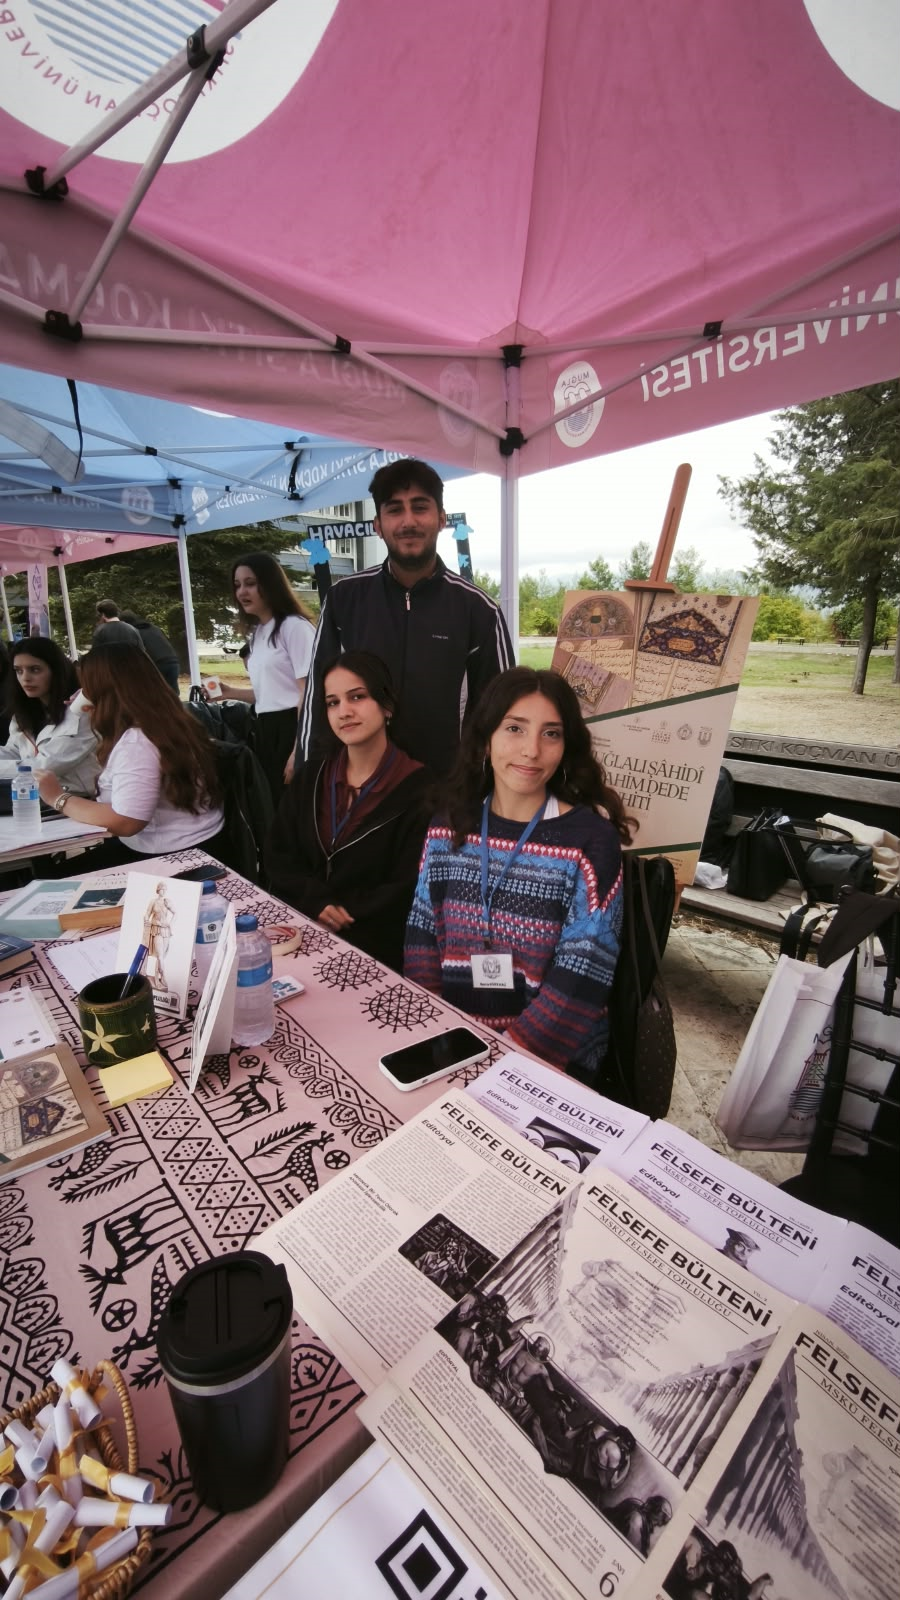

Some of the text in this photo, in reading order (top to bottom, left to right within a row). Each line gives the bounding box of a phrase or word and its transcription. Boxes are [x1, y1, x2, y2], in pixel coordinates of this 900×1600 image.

[594, 751, 646, 774] UĞLALI
[730, 736, 774, 752] SITKI
[781, 742, 876, 764] KOÇMAN
[605, 772, 690, 801] AHİM DEDE
[620, 791, 652, 811] HİTİ
[500, 1069, 559, 1106] FELSEFE
[557, 1101, 625, 1139] BÜLTENİ
[440, 1101, 503, 1151] FELSEFE
[650, 1142, 726, 1196] FELSEFE
[726, 1191, 819, 1250] BÜLTENİ
[686, 1181, 724, 1207] FELSEFE
[586, 1185, 670, 1255] FELSEFE
[669, 1250, 774, 1328] BÜLTENİ
[624, 1235, 666, 1270] FELSEFE
[666, 1266, 732, 1318] TOPLULUĞU
[795, 1332, 900, 1435] FELSEF
[599, 1571, 619, 1598] 6
